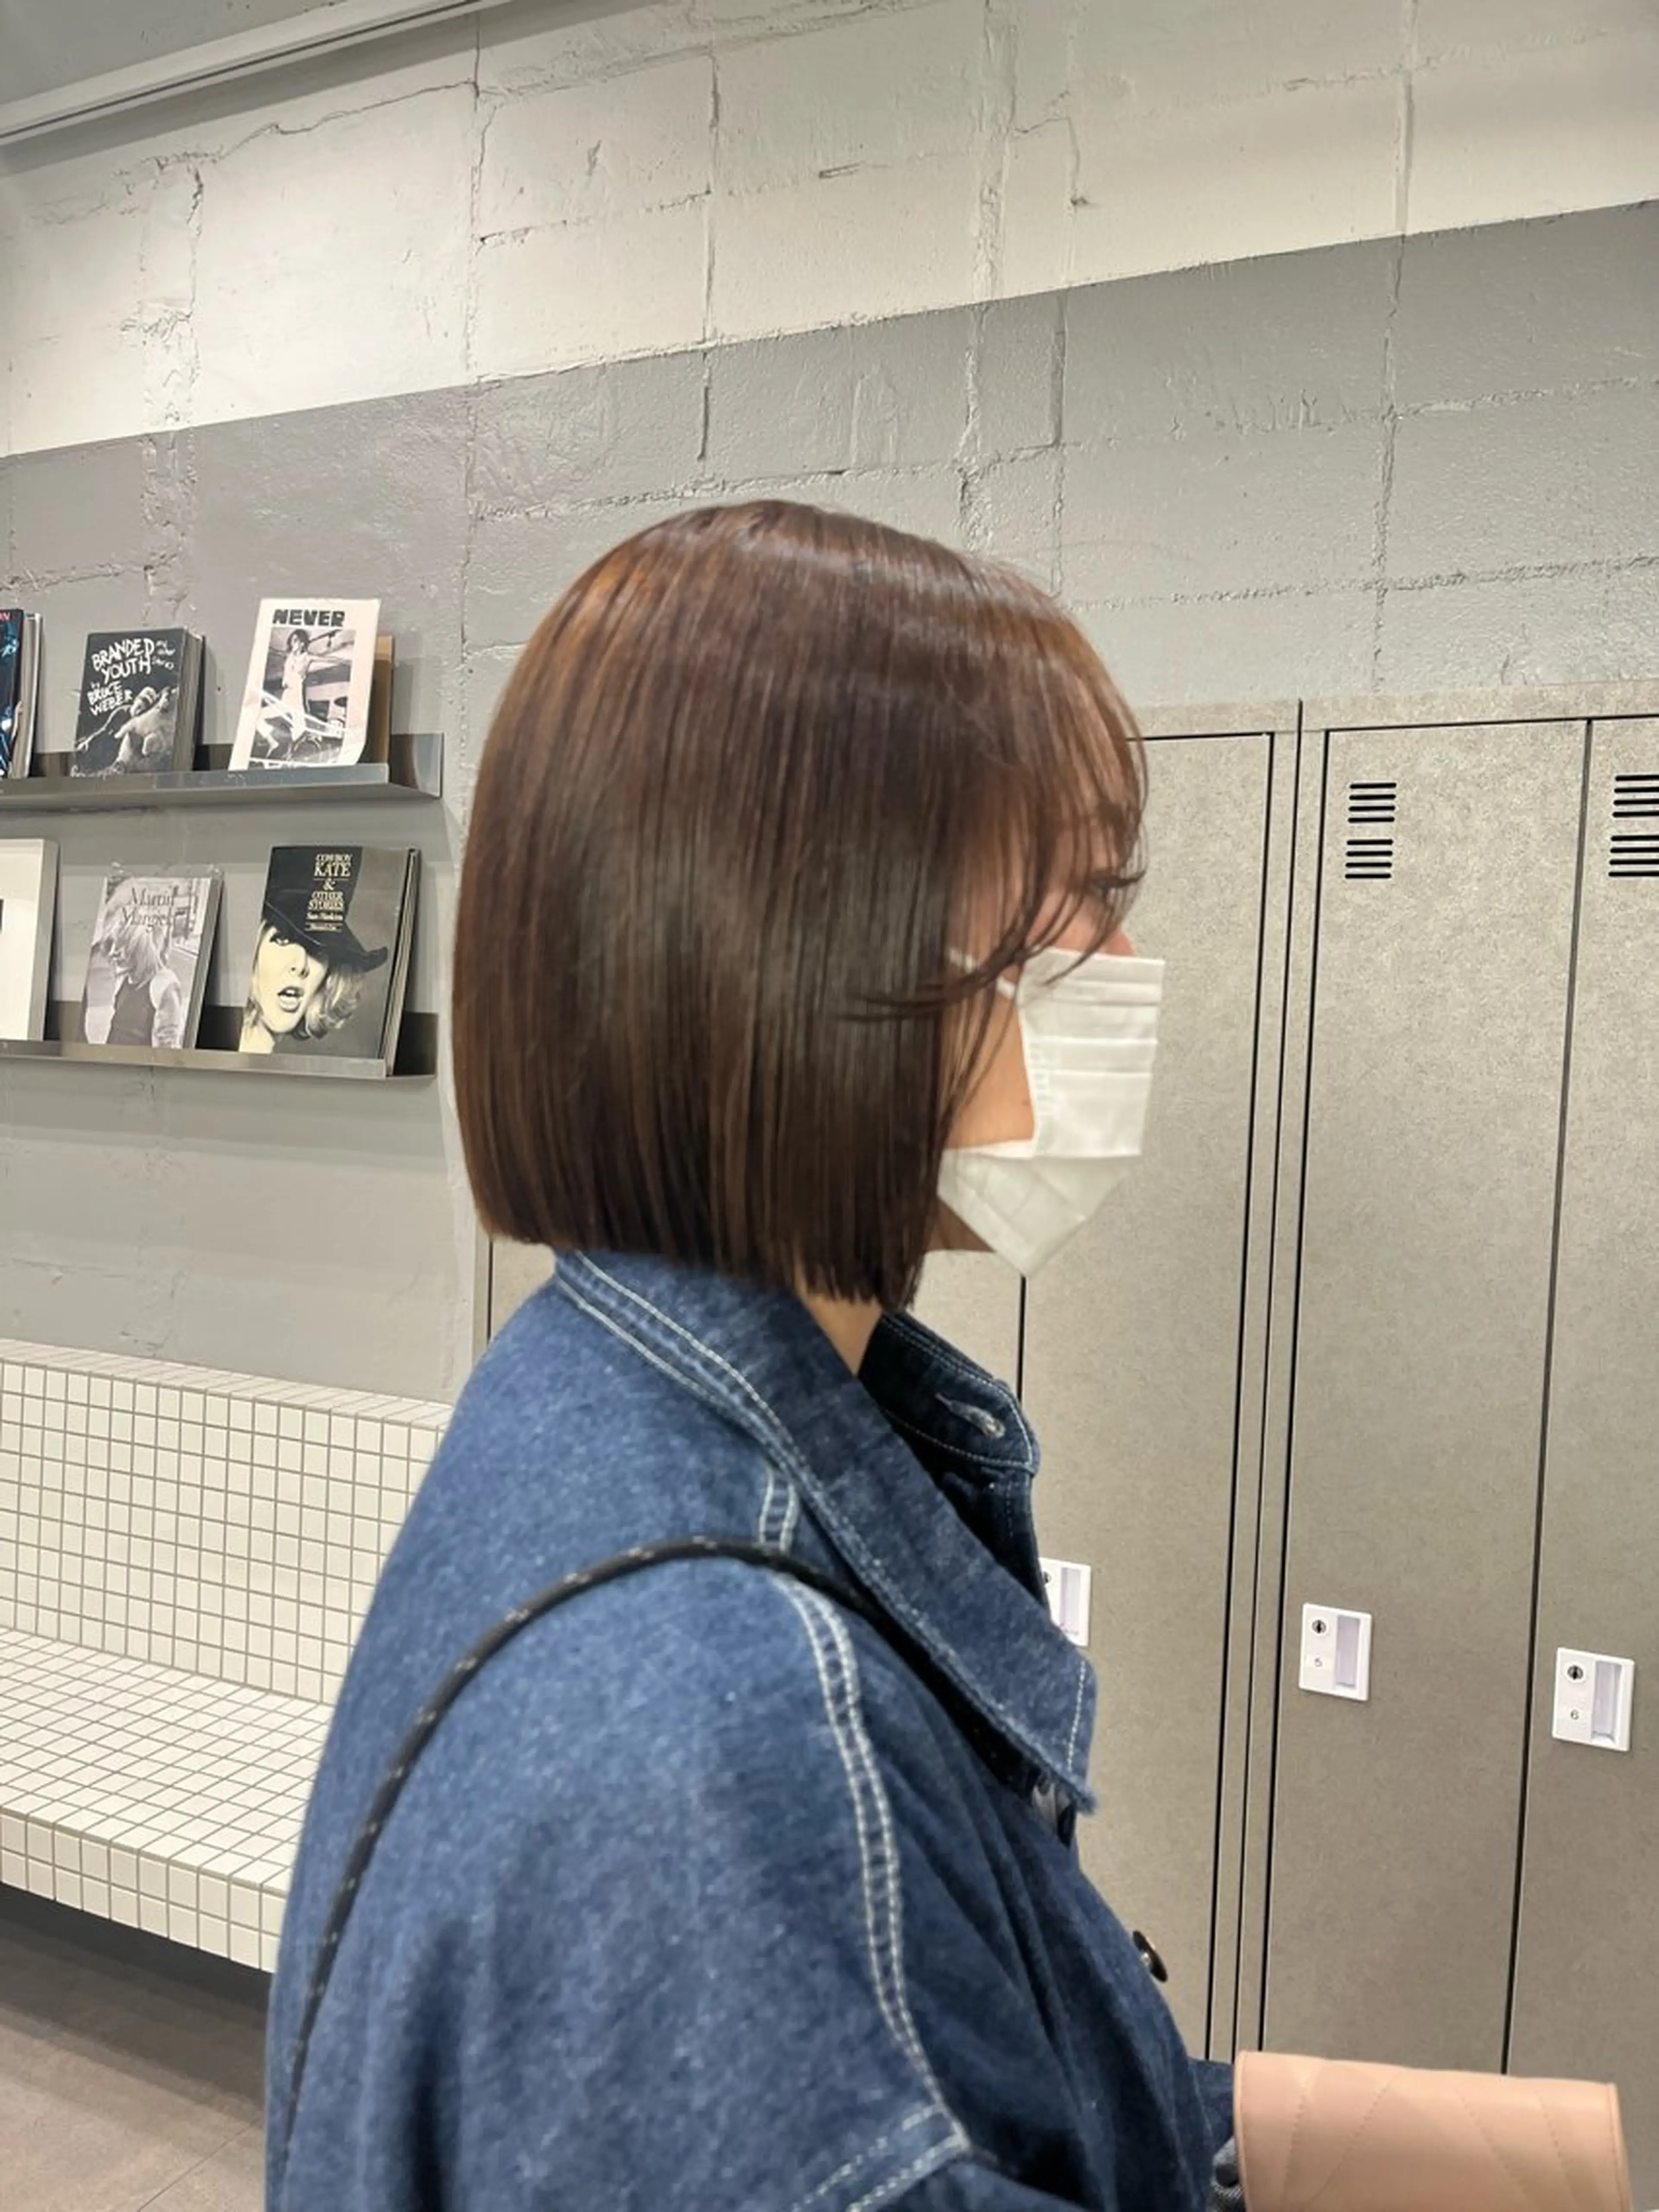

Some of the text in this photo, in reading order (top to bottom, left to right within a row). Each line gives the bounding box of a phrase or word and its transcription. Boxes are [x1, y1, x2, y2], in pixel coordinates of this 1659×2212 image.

[272, 609, 345, 627] NEVER
[92, 638, 155, 671] BRANDED
[101, 656, 151, 685] YOUTH
[87, 681, 122, 705] BRUCE
[89, 690, 133, 716] WEBER
[314, 862, 352, 877] KATE
[323, 878, 336, 890] &
[311, 891, 344, 900] OTHER
